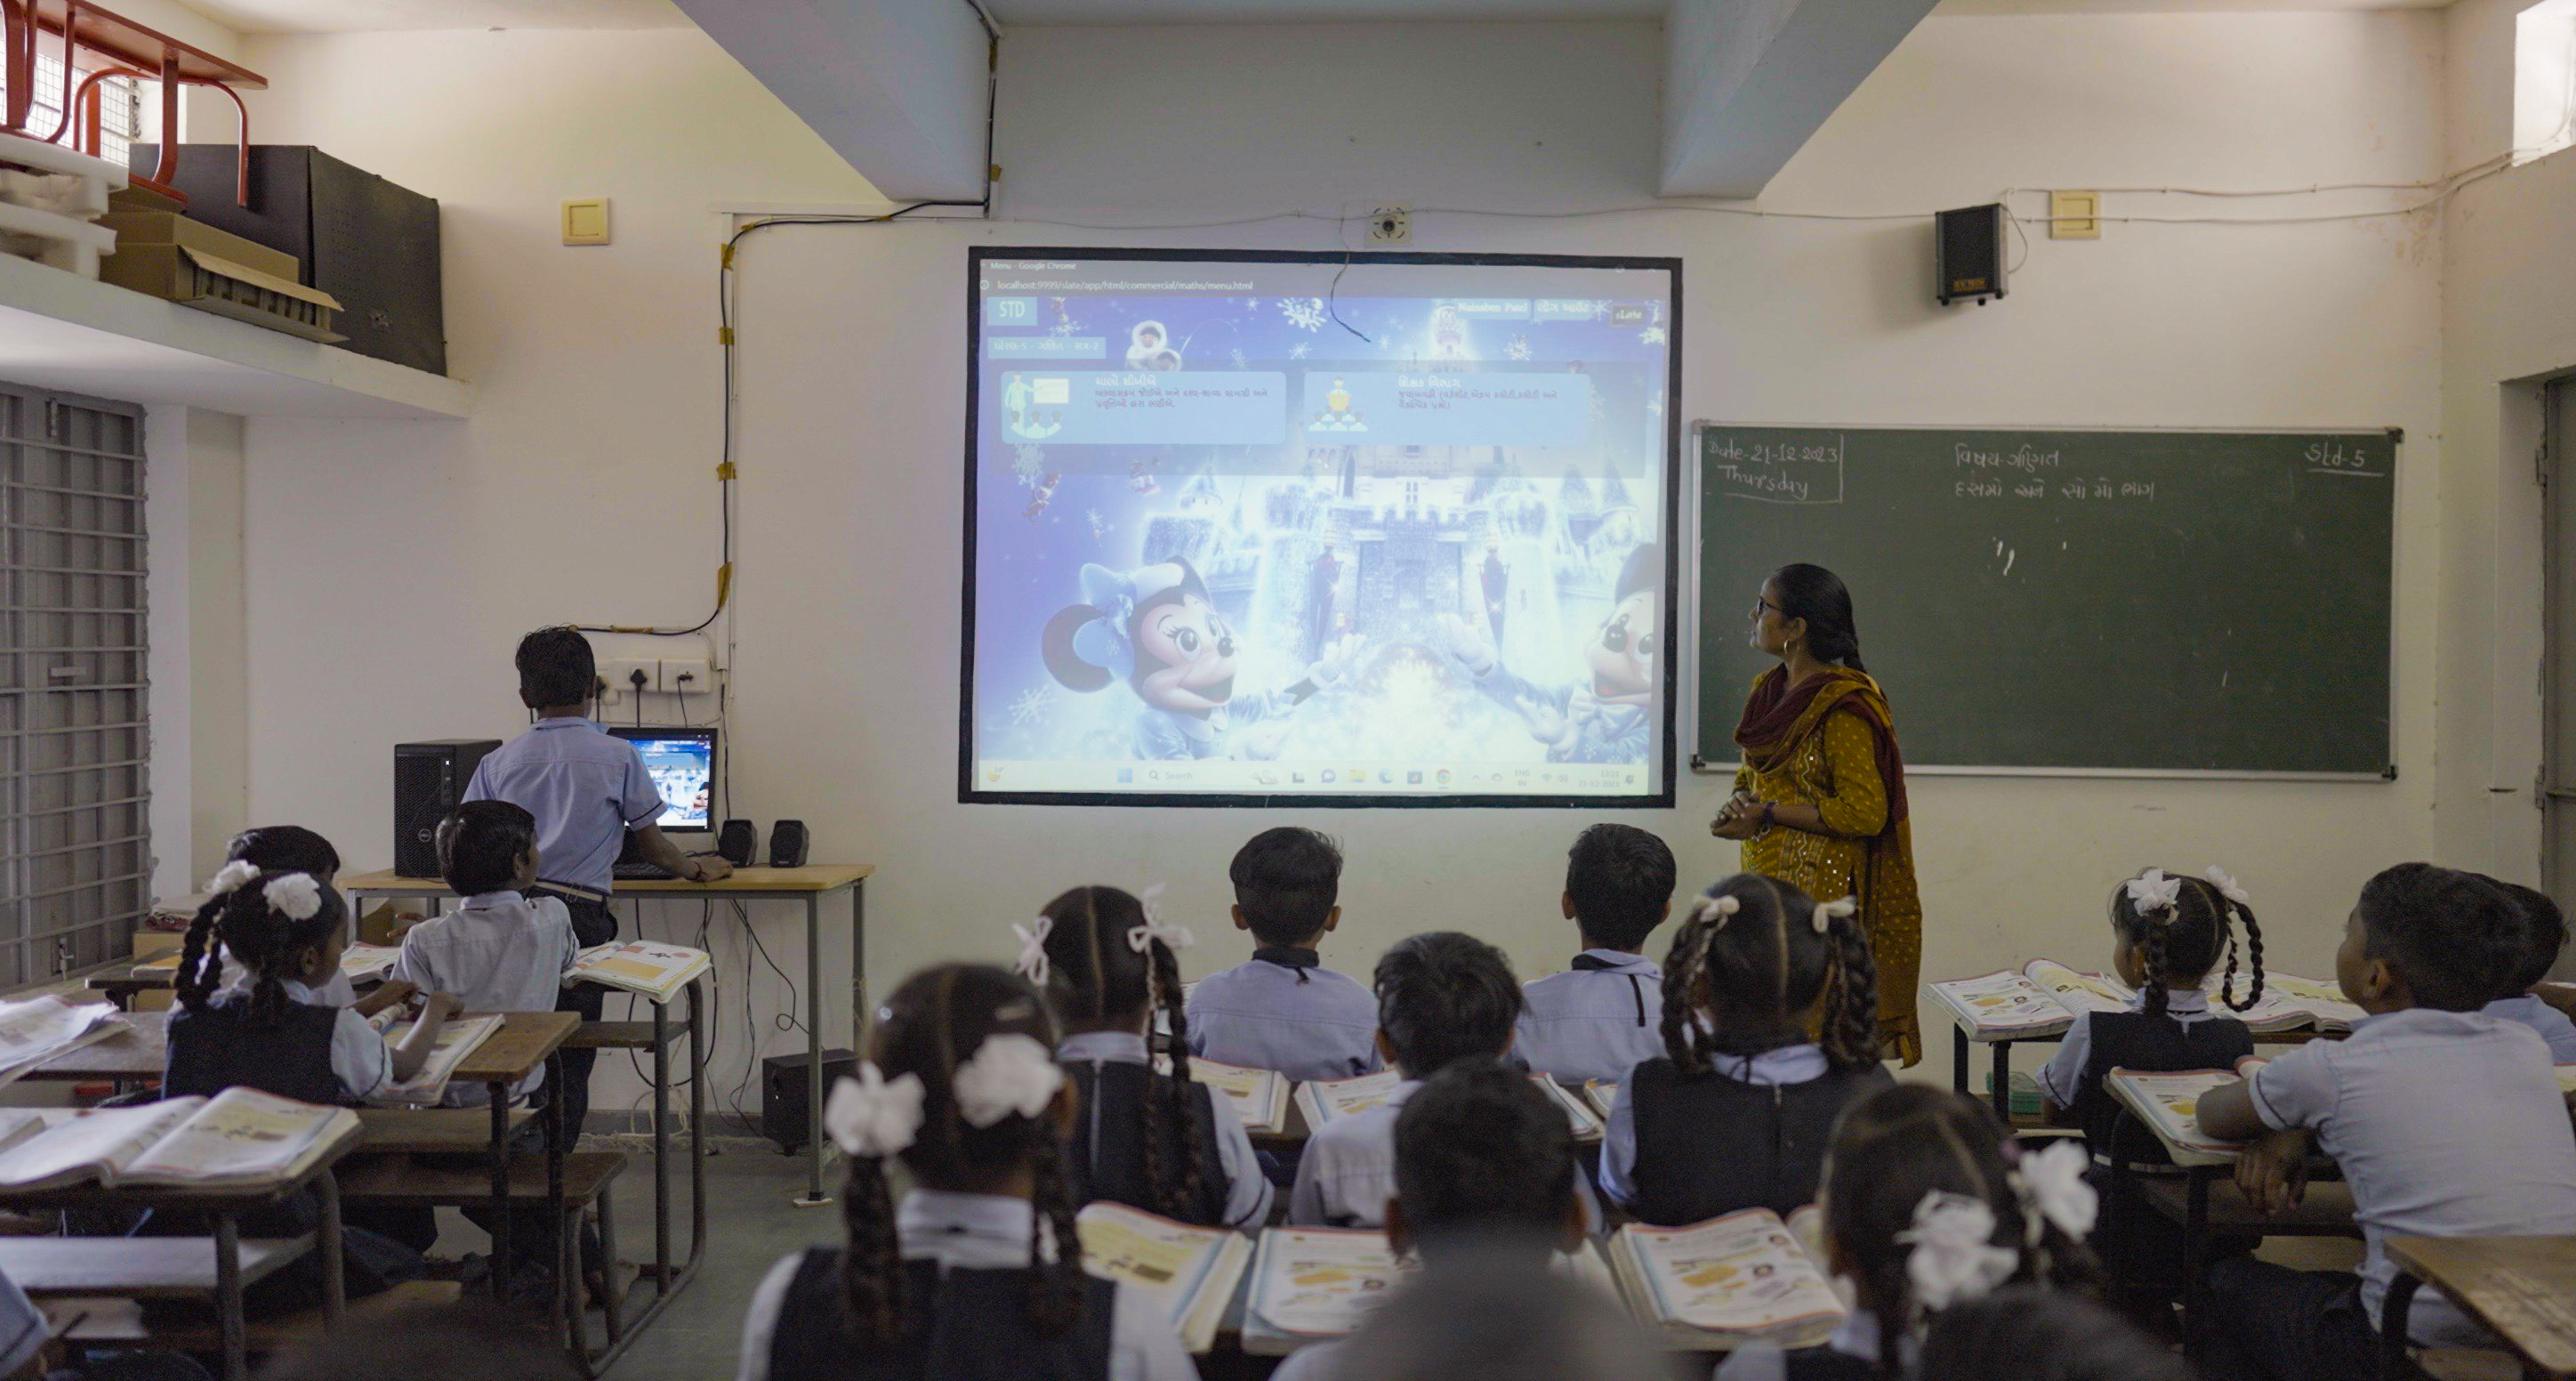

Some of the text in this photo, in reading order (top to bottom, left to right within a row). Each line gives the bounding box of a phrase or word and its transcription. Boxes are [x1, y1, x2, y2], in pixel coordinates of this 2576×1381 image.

[990, 262, 1011, 270] Menu
[1018, 262, 1045, 271] Google
[1047, 262, 1076, 270] Chrome
[998, 301, 1026, 318] STD
[1095, 374, 1119, 386] ચાલો
[1429, 375, 1461, 388] વિભાગ
[1717, 464, 1808, 501] Thursday
[2014, 477, 2045, 498] અને
[2121, 481, 2155, 503] ભાગ
[1165, 771, 1193, 780] Search
